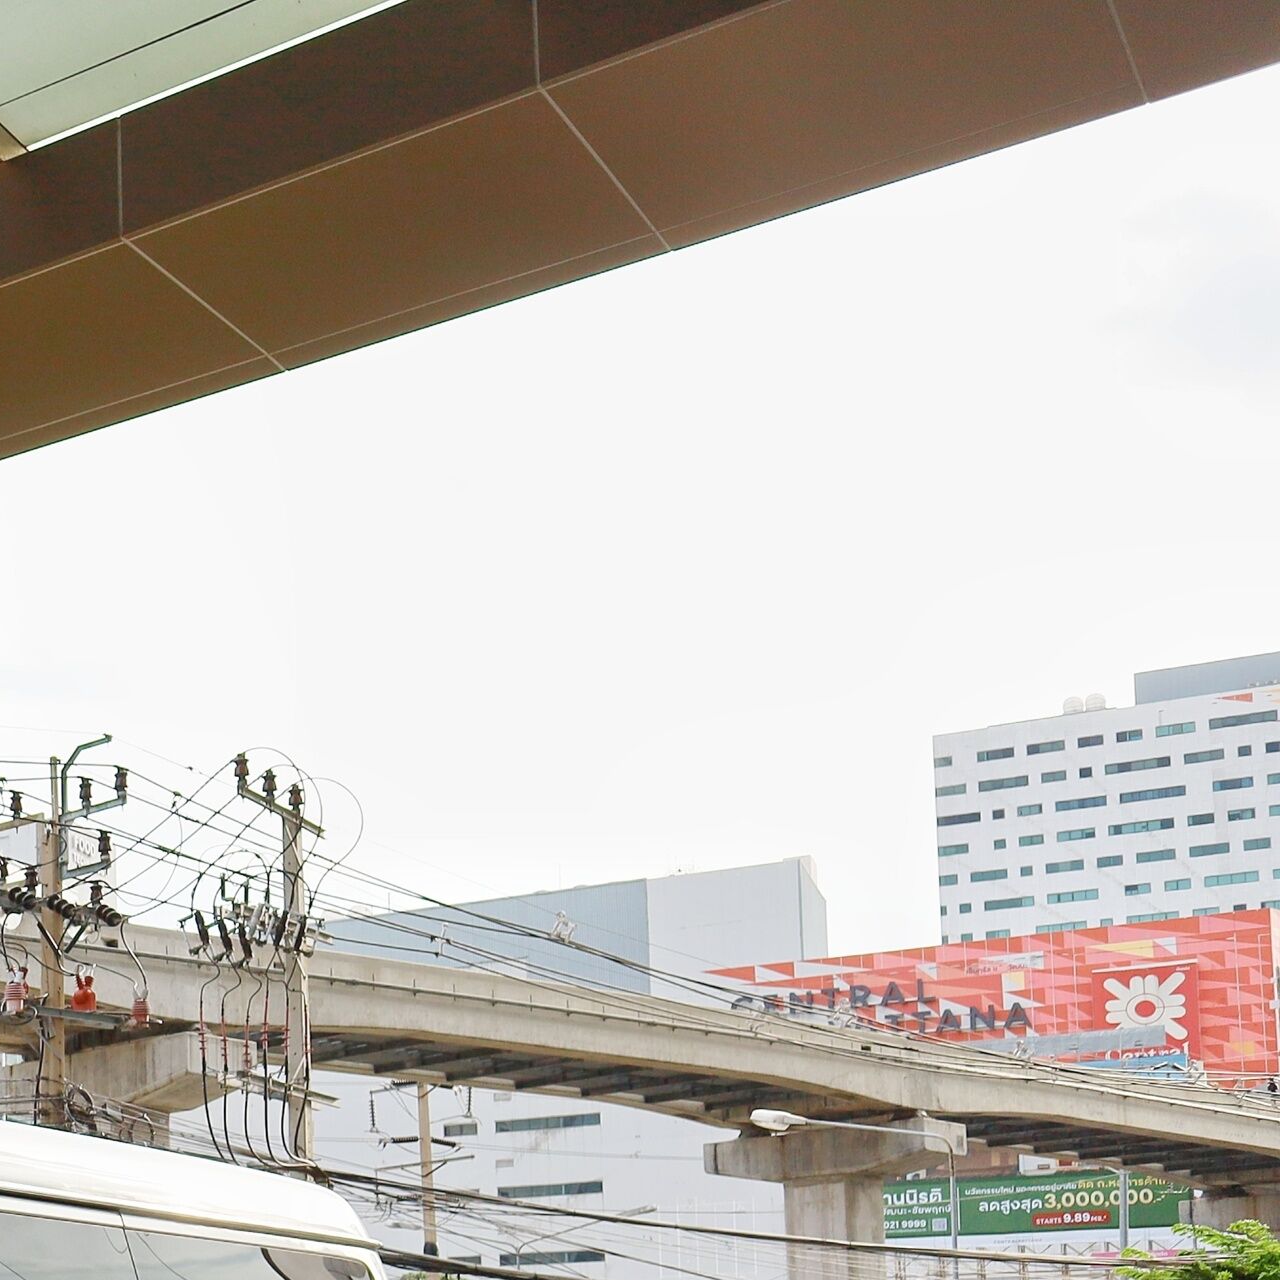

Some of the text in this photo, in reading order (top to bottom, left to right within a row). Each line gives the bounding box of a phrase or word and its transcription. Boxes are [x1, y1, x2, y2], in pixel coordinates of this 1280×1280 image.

[978, 1198, 1042, 1215] ลดสูงสุด
[1063, 1212, 1091, 1224] 9.89
